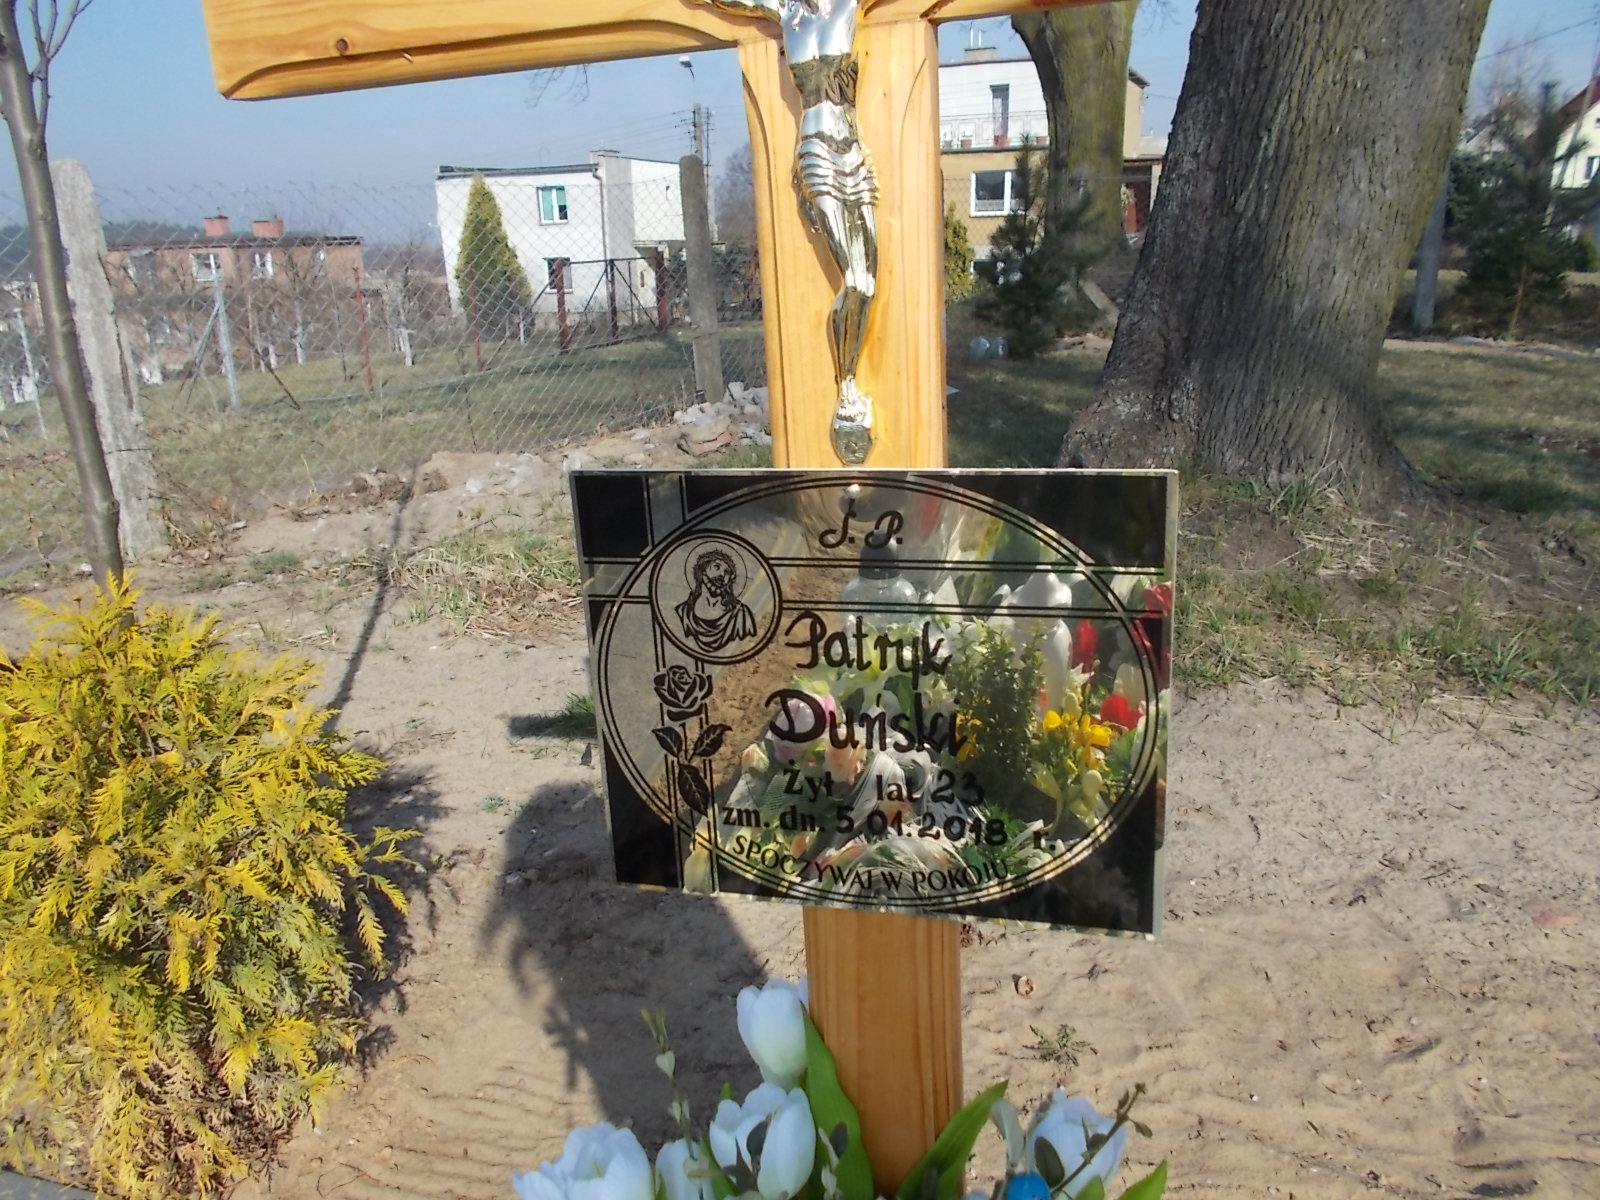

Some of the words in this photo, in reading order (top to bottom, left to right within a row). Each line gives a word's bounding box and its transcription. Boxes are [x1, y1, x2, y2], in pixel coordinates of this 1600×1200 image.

[784, 610, 953, 691] Patryk
[764, 688, 968, 757] Duński
[783, 759, 835, 802] Żył
[876, 774, 917, 803] lat
[930, 769, 985, 807] 23
[722, 806, 771, 828] zm.
[779, 805, 826, 832] dn.
[1031, 830, 1057, 851] r.
[881, 870, 903, 892] W
